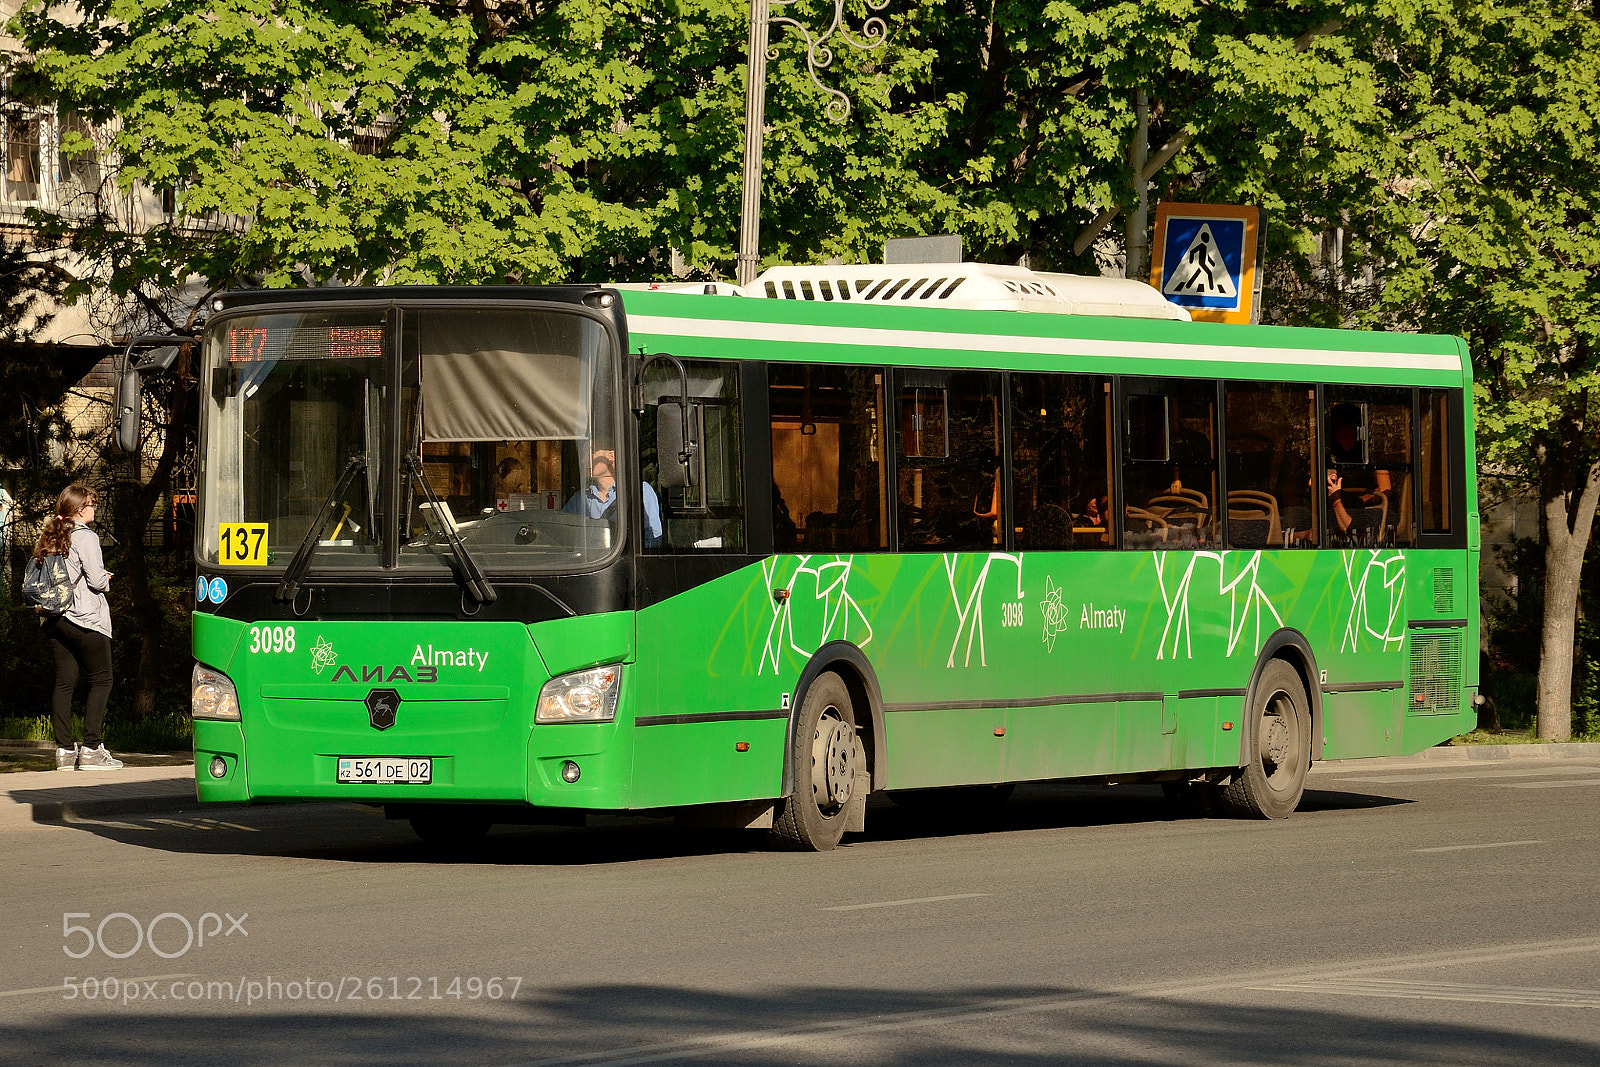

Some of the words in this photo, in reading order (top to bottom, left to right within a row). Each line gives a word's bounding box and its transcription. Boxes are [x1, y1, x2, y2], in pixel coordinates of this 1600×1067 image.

[229, 328, 267, 362] 137
[221, 527, 266, 561] 137
[1001, 602, 1023, 627] 3098
[1079, 602, 1126, 634] Almaty
[249, 625, 296, 654] 3098
[410, 644, 489, 672] Almaty
[330, 665, 438, 683] ЛИАЗ
[340, 770, 351, 778] KZ
[355, 761, 382, 778] 561
[386, 765, 404, 778] DE
[410, 762, 428, 778] 02
